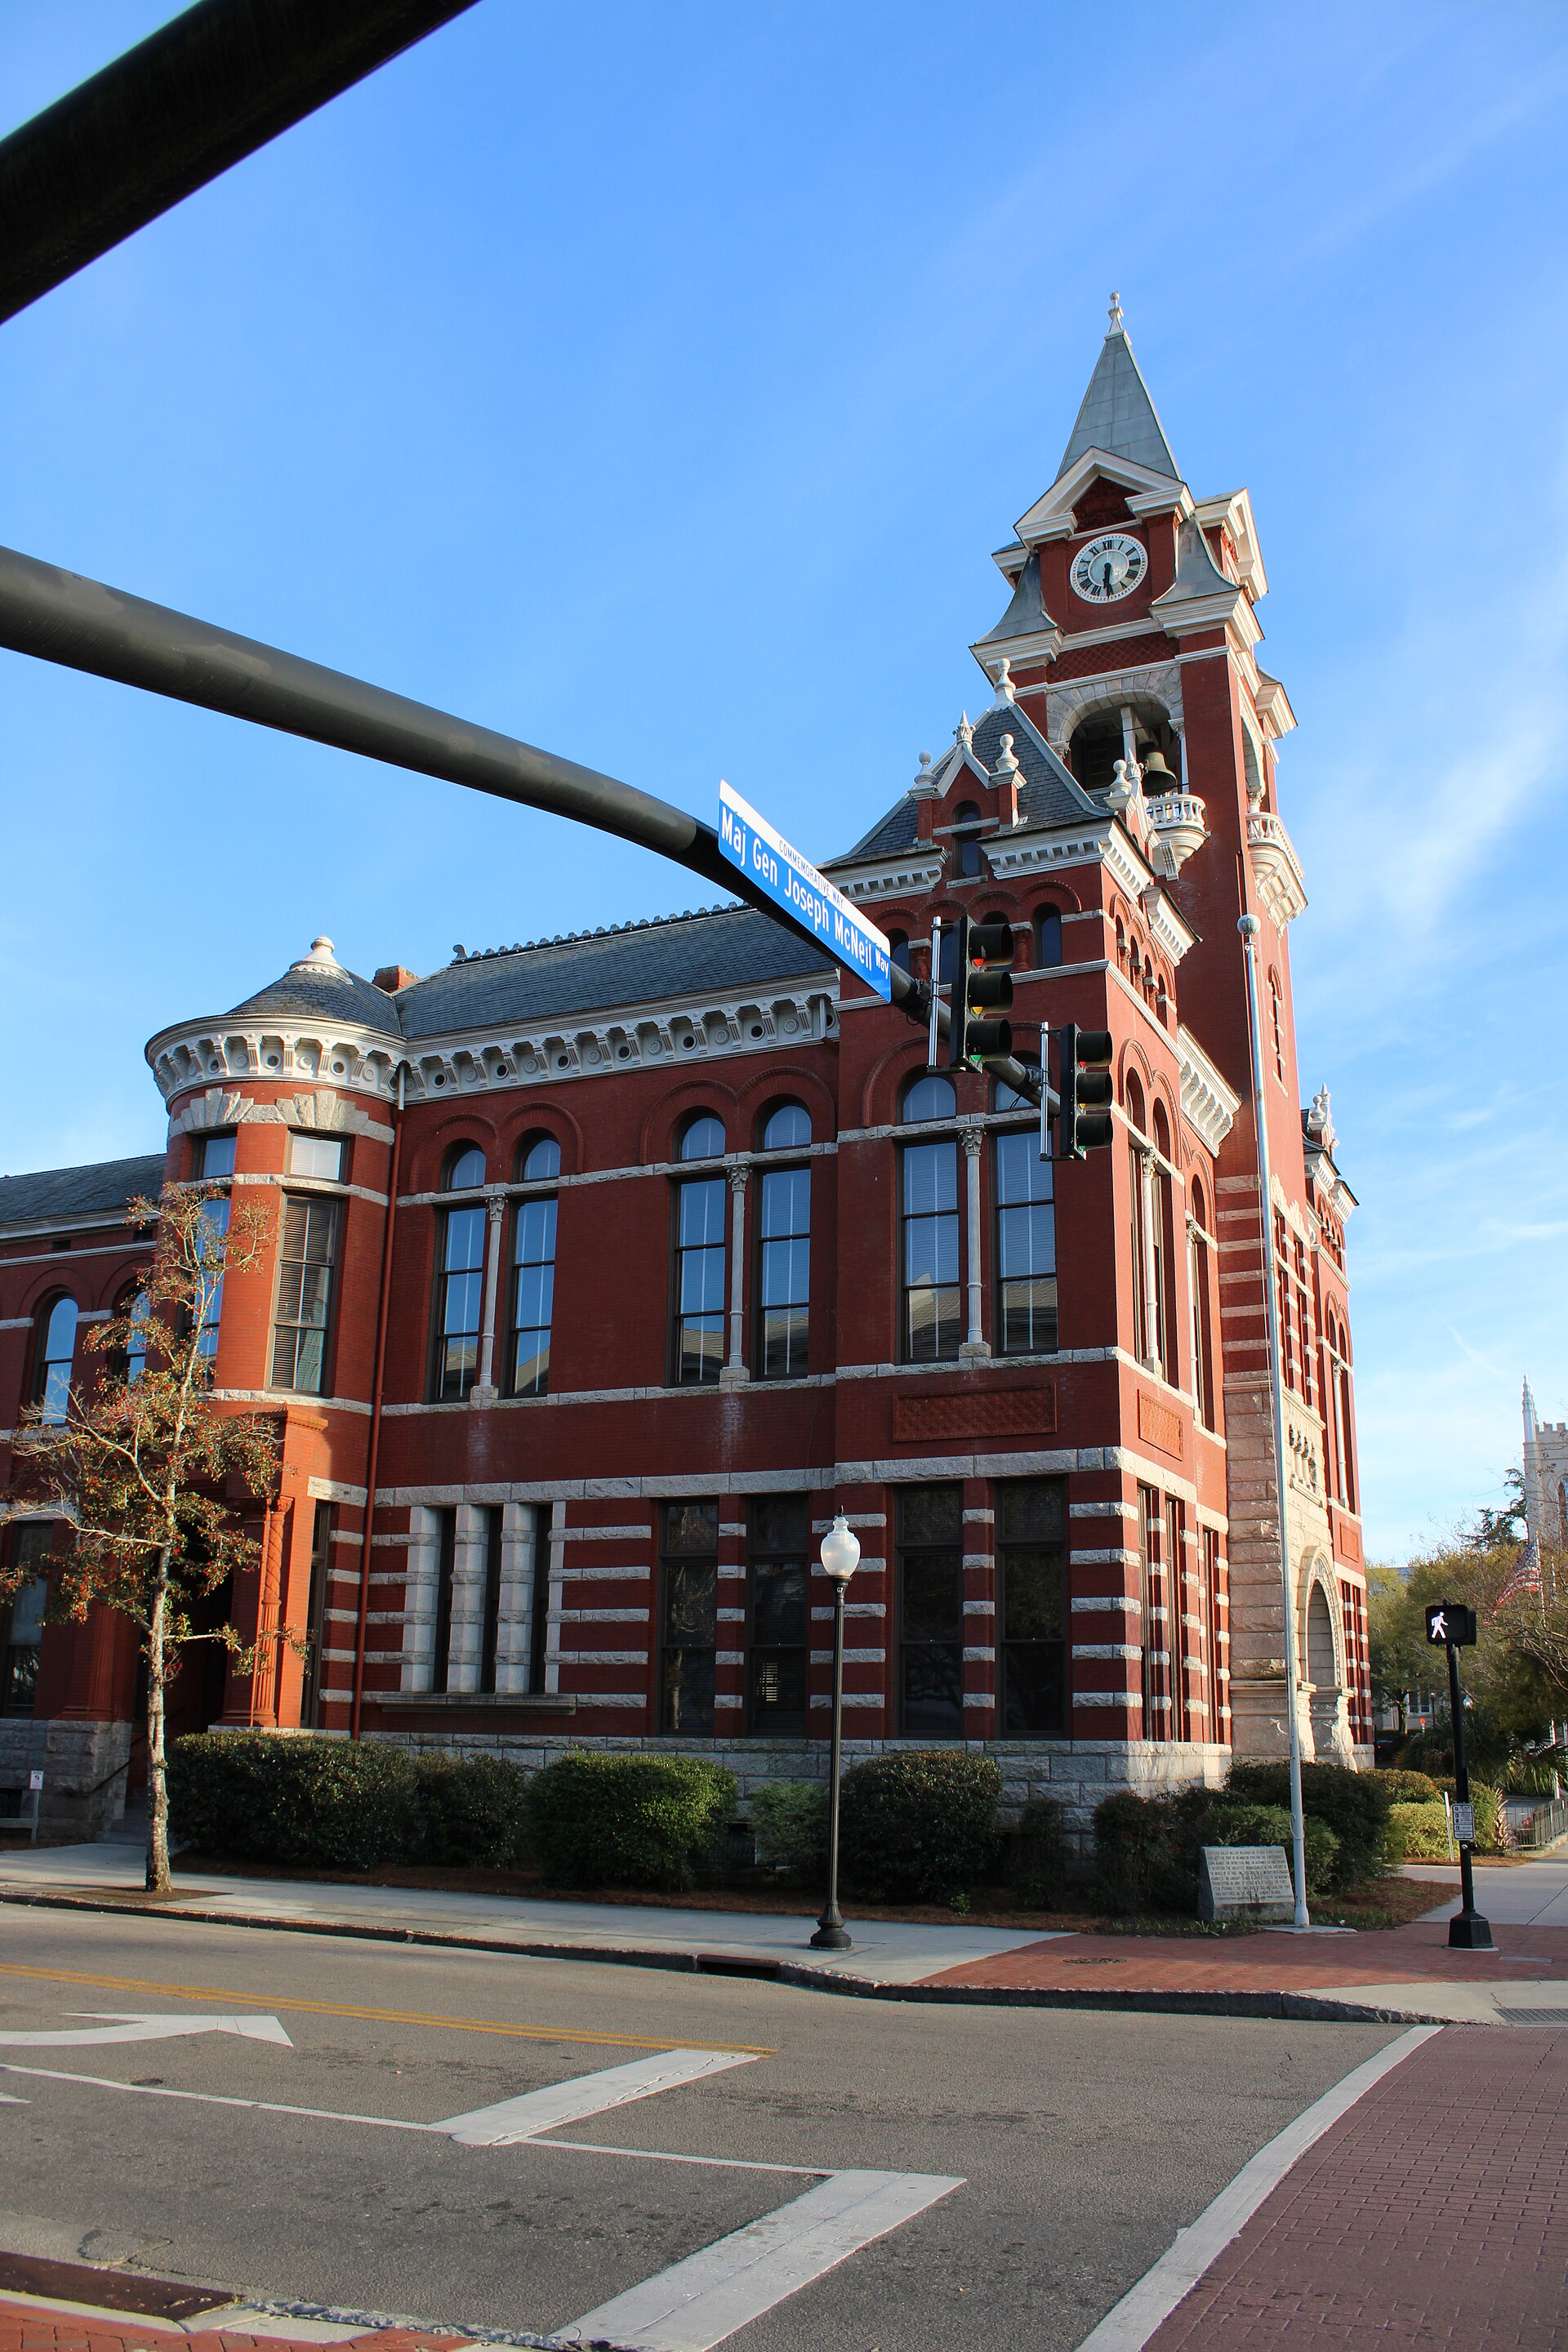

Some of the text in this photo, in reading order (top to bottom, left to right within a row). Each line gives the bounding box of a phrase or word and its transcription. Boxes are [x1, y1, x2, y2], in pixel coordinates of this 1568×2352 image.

[721, 806, 889, 980] Maj Gen Joseph McNeil Way
[779, 840, 844, 909] COMMEMORATIVE WAY
